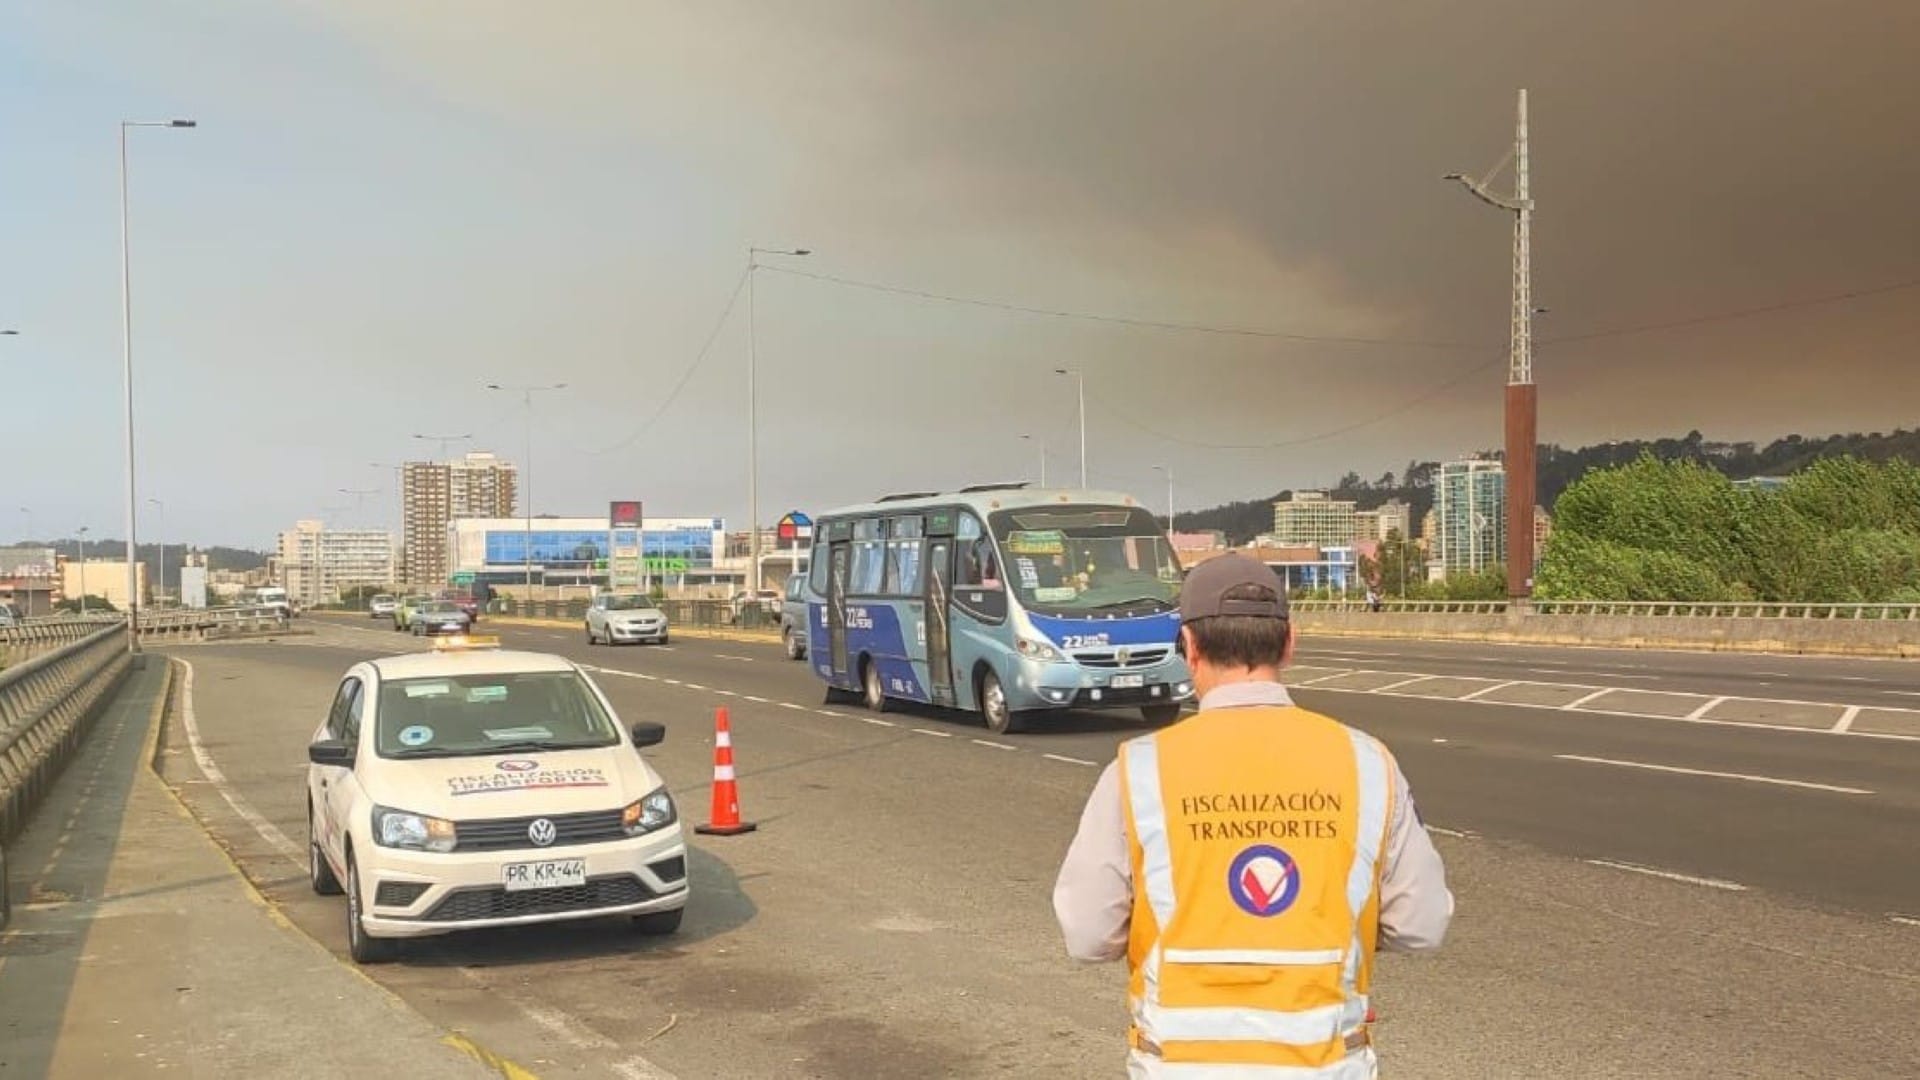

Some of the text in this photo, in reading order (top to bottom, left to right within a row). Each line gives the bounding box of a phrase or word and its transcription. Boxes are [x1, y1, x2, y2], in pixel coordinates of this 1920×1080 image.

[1062, 635, 1082, 649] 22
[1181, 787, 1342, 816] FISCALIZACIÓN
[1188, 820, 1338, 841] TRANSPORTES
